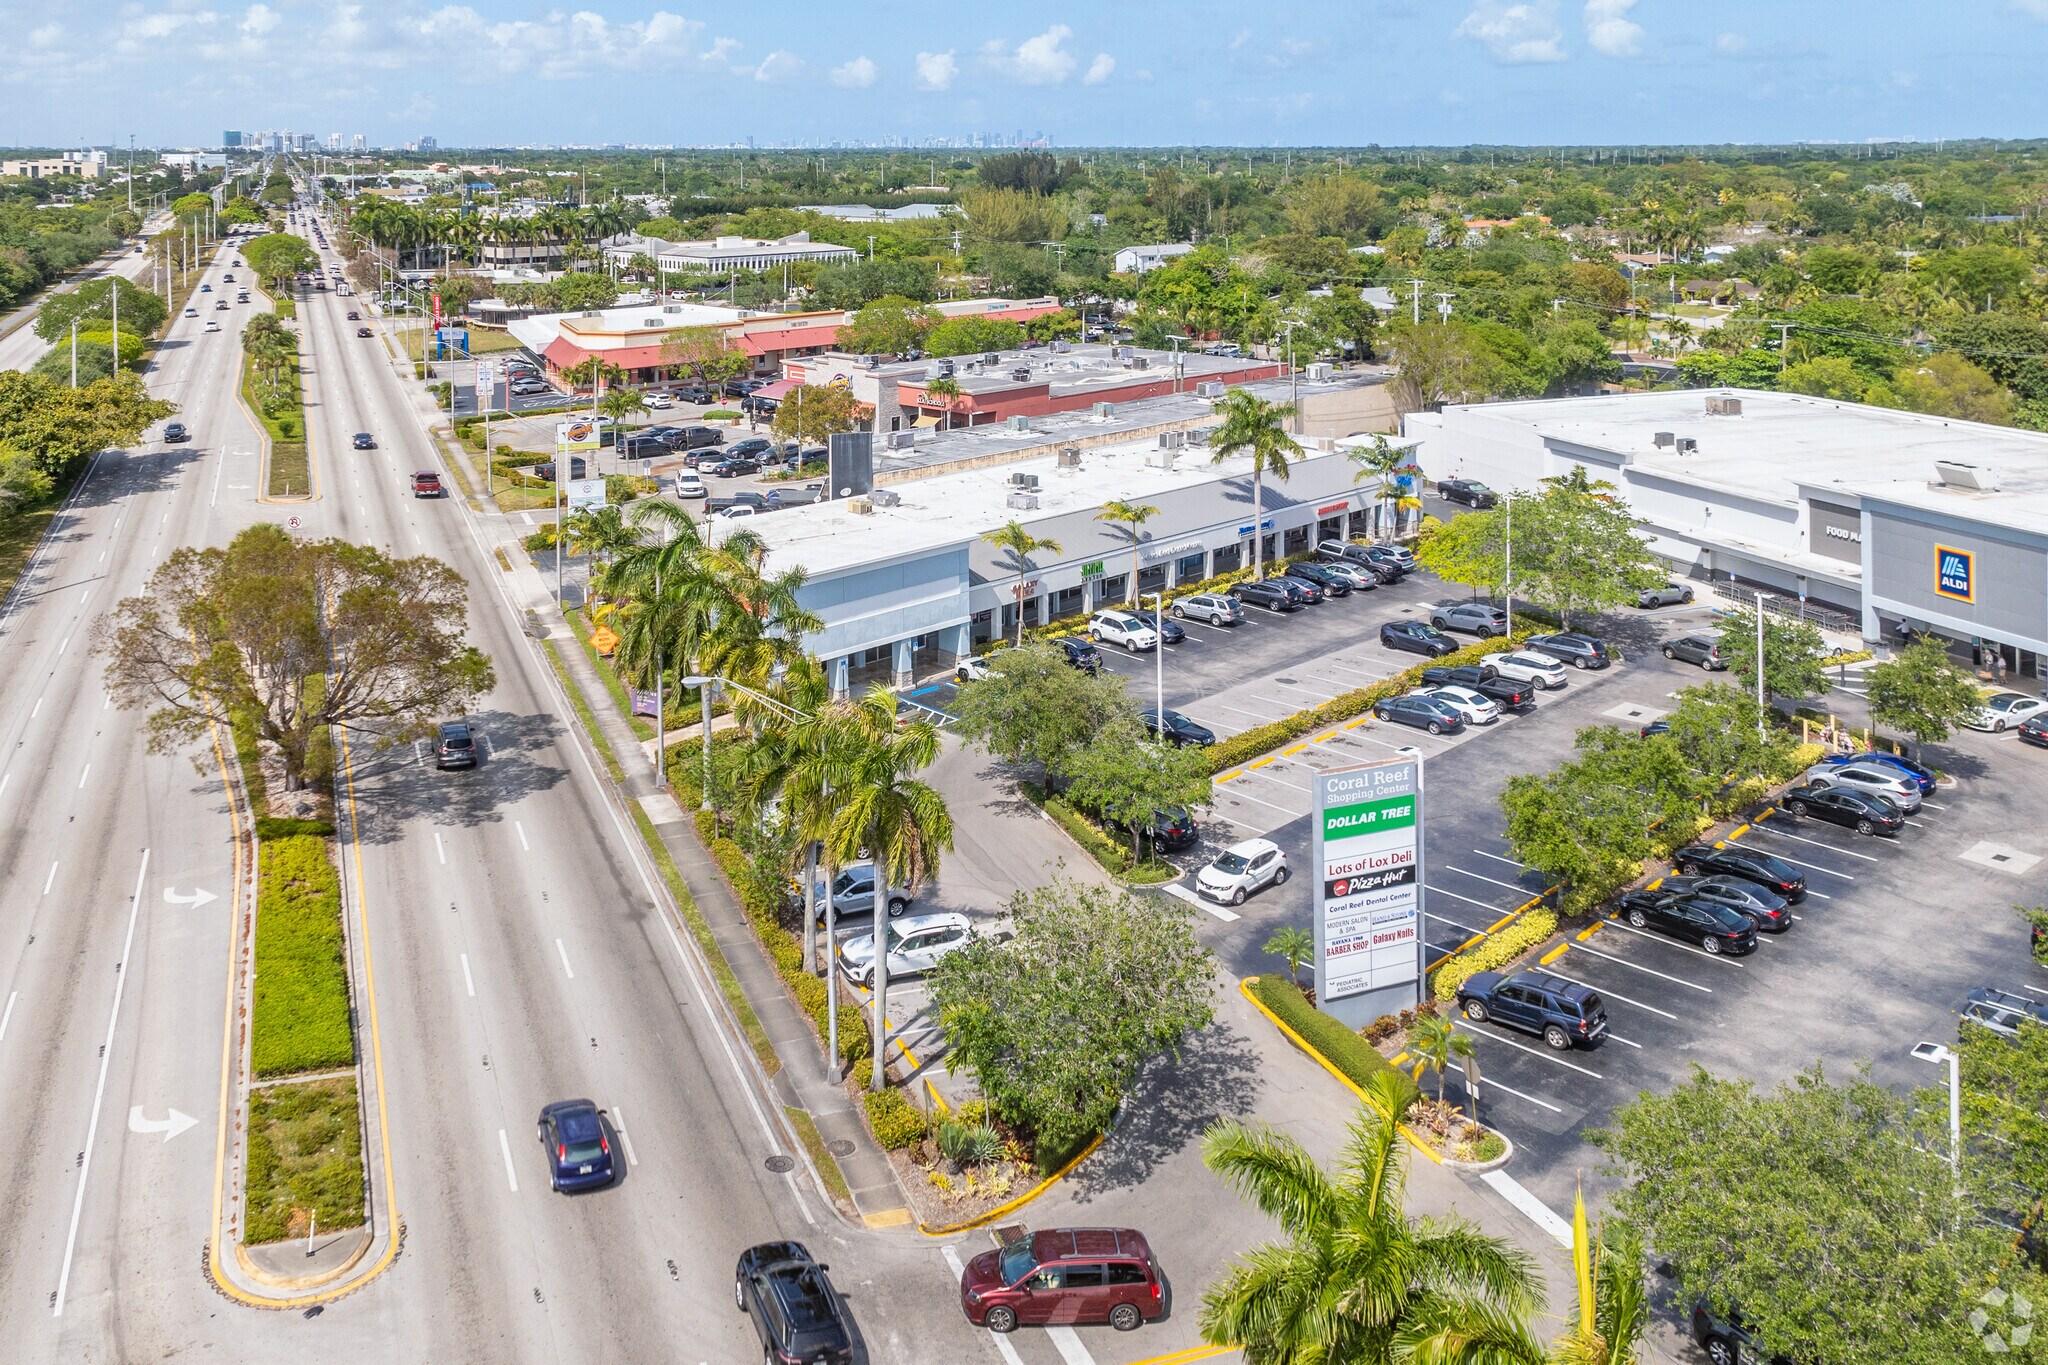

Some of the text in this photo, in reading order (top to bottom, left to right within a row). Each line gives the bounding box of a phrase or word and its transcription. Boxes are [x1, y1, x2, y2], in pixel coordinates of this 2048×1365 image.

[1826, 525, 1849, 540] FOOD
[1941, 576, 1968, 591] ALDI
[1327, 766, 1410, 793] Coral Reef
[1327, 783, 1410, 804] Shopping Center
[1327, 805, 1412, 830] DOLLAR TREE
[1329, 850, 1412, 876] Lots of Lox Deli
[1347, 868, 1408, 895] Pizza Hut
[1329, 892, 1412, 913] Coral Reef Dental Center
[1326, 919, 1350, 929] MODERN
[1350, 916, 1368, 925] SALON
[1373, 928, 1414, 944] Galaxy Nails
[1326, 940, 1369, 957] BARBER SHOP
[1337, 982, 1368, 993] ASSOCIATES
